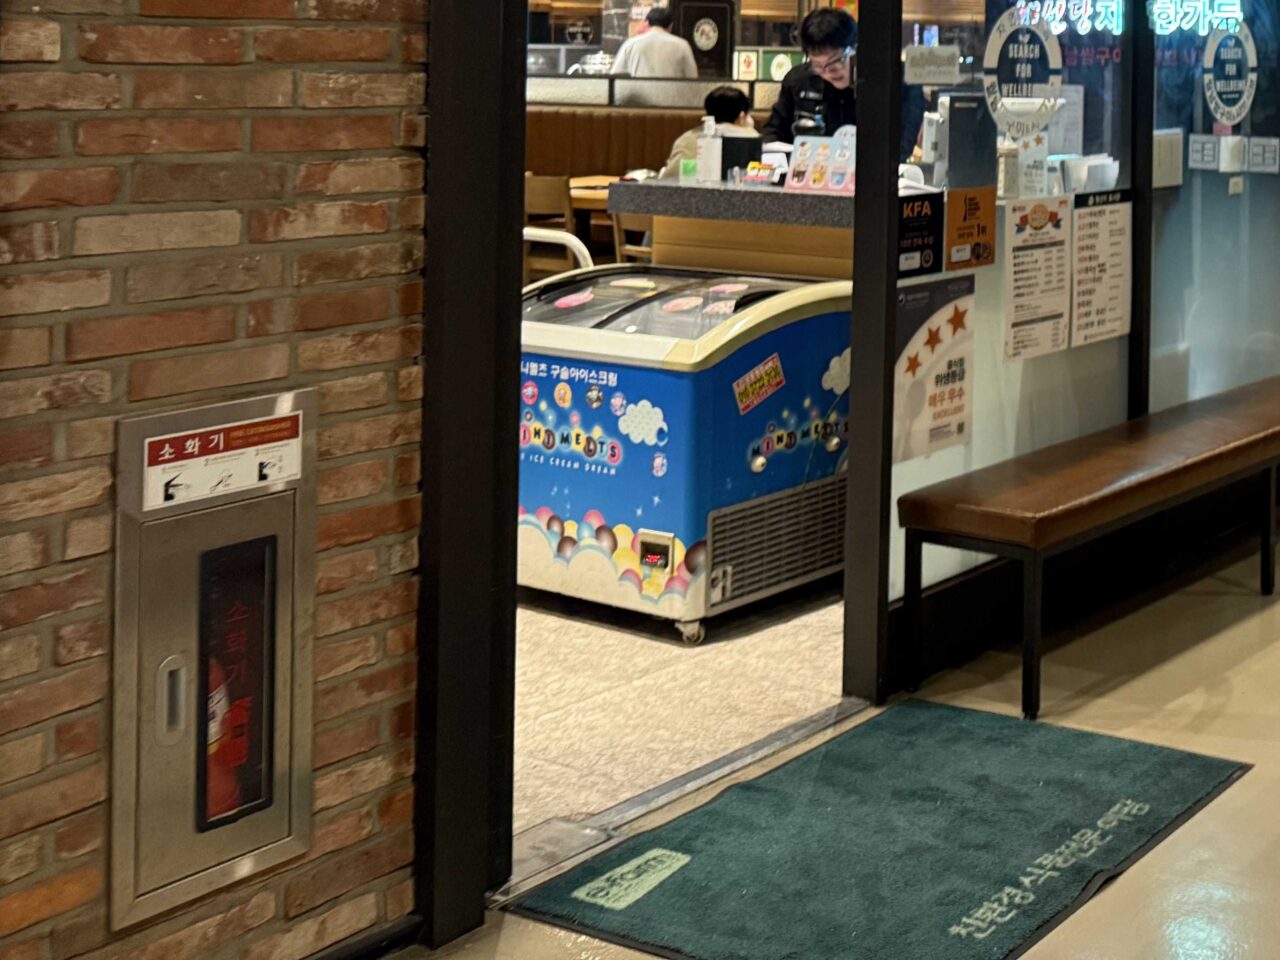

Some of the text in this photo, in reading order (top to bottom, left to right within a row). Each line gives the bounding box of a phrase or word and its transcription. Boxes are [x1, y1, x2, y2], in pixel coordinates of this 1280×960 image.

[1008, 43, 1040, 59] SEARCH
[1015, 64, 1032, 79] FOR
[903, 200, 931, 218] KFA
[520, 360, 618, 387] 니멜츠 구슬아이스크림
[560, 431, 618, 459] MELTS
